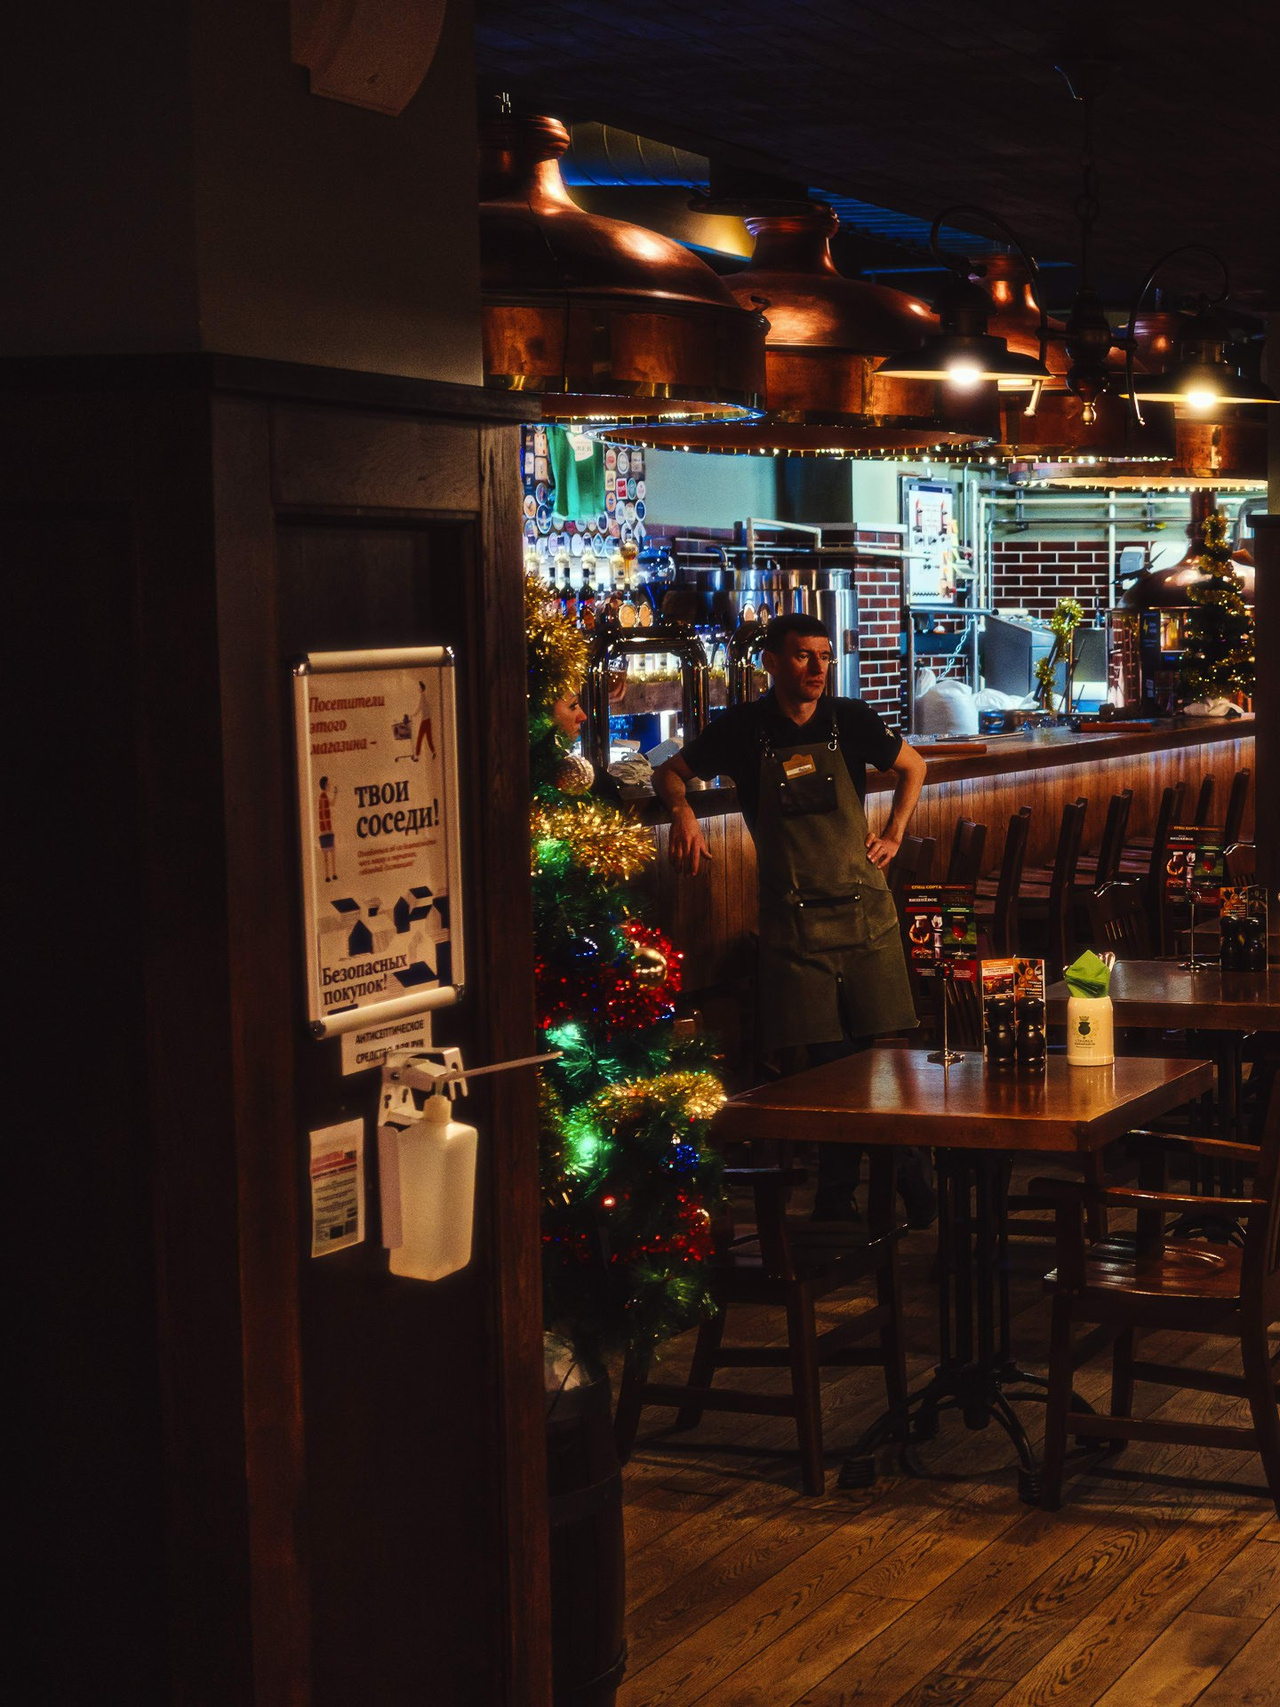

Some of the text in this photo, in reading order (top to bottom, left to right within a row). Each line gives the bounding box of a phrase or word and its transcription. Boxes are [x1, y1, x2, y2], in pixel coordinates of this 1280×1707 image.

[309, 695, 385, 713] Посетители
[310, 719, 347, 734] этого
[310, 738, 367, 755] магазина
[356, 797, 440, 839] соседи!
[322, 954, 408, 986] Безопасных
[323, 973, 388, 1006] покупок!
[355, 1019, 425, 1044] АНТИСЕПТИЧЕСКОЕ
